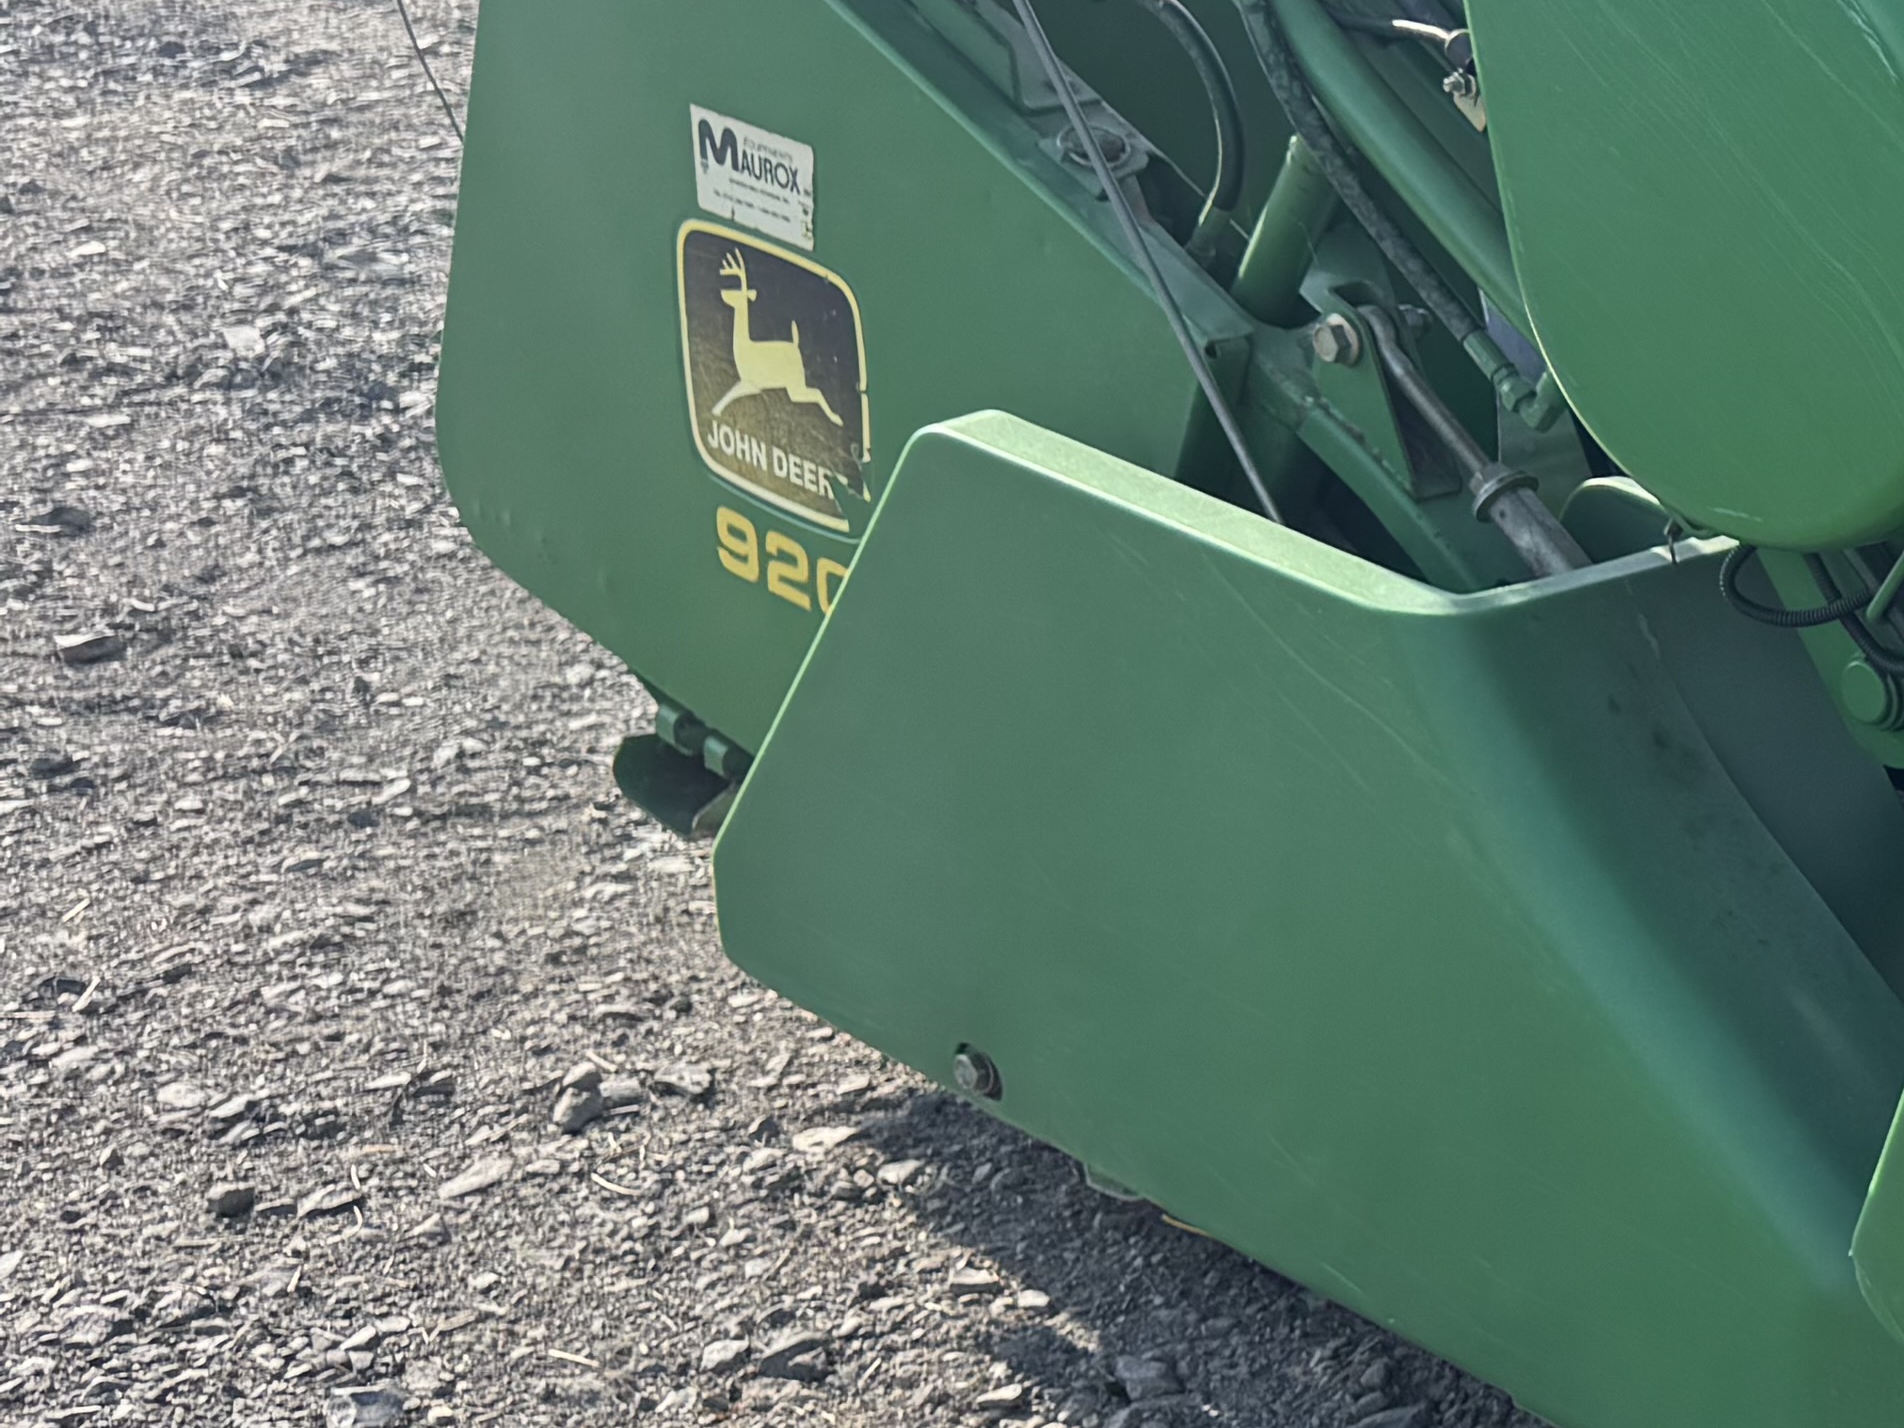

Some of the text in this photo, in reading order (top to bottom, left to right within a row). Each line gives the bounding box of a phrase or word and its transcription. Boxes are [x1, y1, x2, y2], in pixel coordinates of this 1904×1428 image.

[698, 118, 801, 196] MAUROX
[706, 420, 848, 500] JOHN DEER
